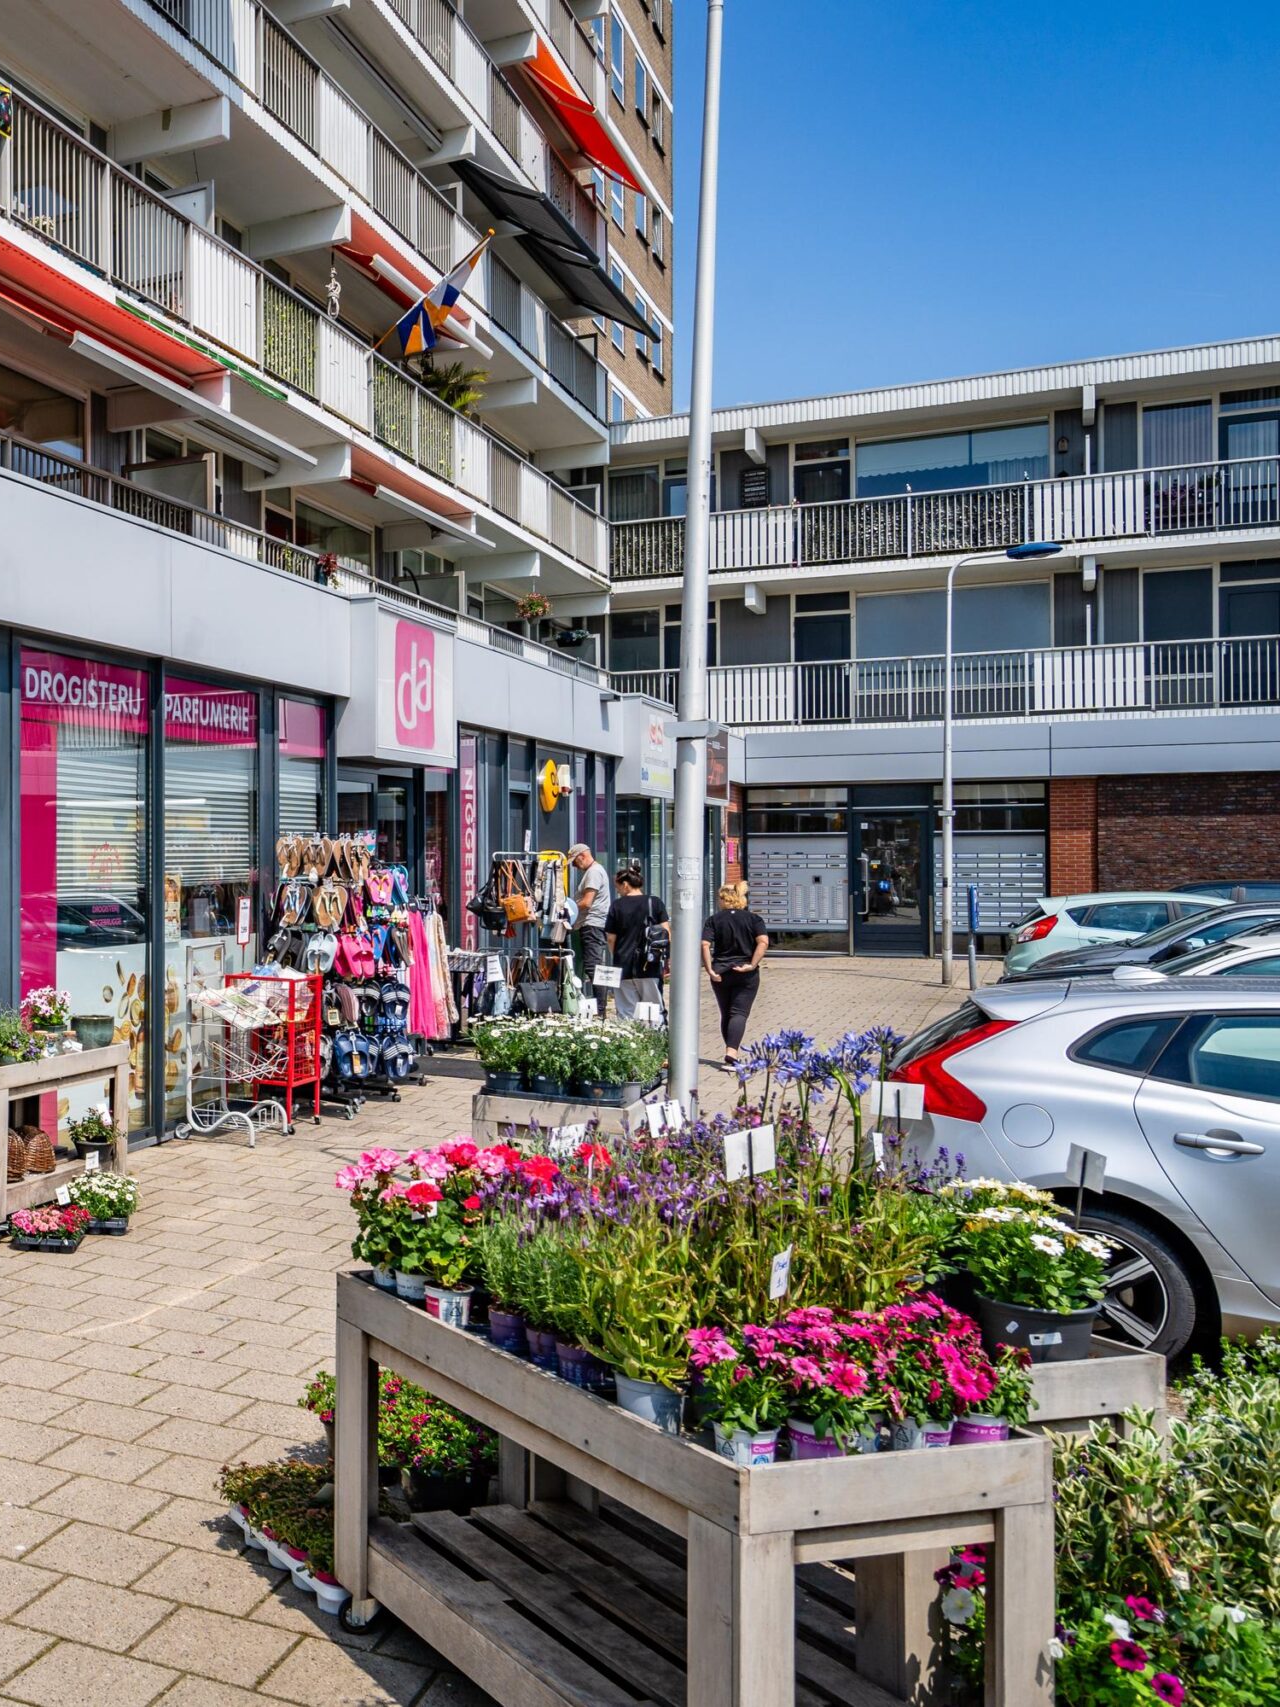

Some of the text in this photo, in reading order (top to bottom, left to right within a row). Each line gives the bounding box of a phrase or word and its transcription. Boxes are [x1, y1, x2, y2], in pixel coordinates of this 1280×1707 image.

[25, 667, 141, 716] DROGISTERIJ
[397, 641, 432, 730] da
[164, 694, 249, 733] PARFUMERIE
